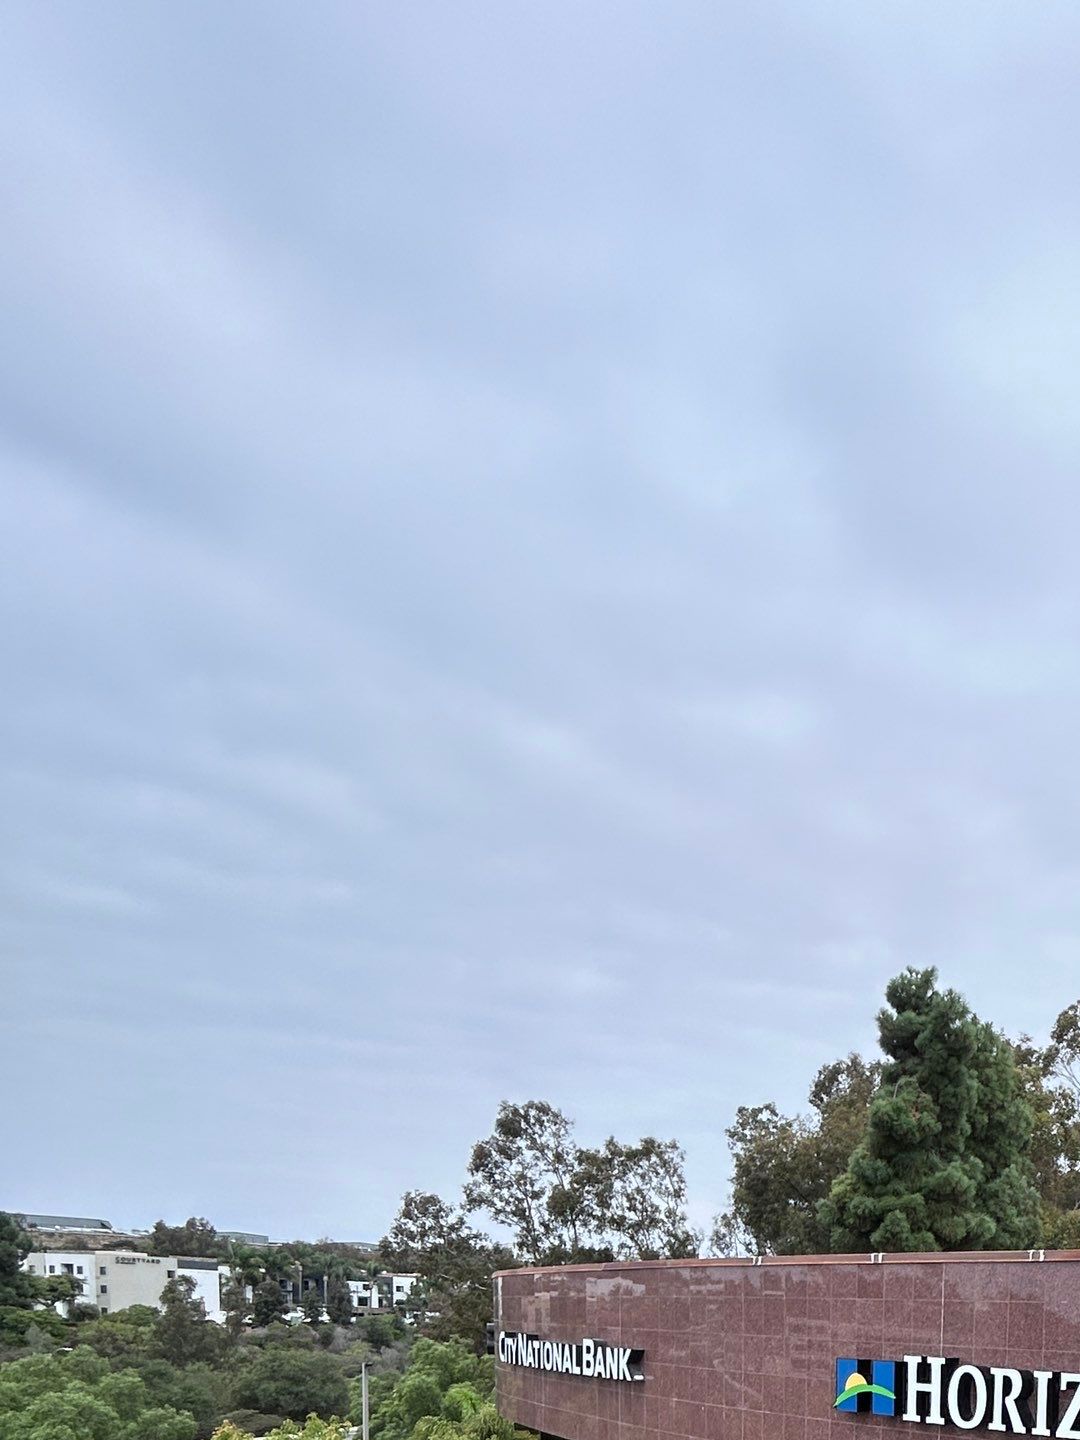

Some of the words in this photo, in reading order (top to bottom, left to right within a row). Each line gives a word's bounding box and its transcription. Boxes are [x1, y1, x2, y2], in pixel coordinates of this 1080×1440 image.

[115, 1256, 161, 1264] COURTYARD
[517, 1332, 581, 1375] NATIONAL
[582, 1338, 632, 1382] BANK
